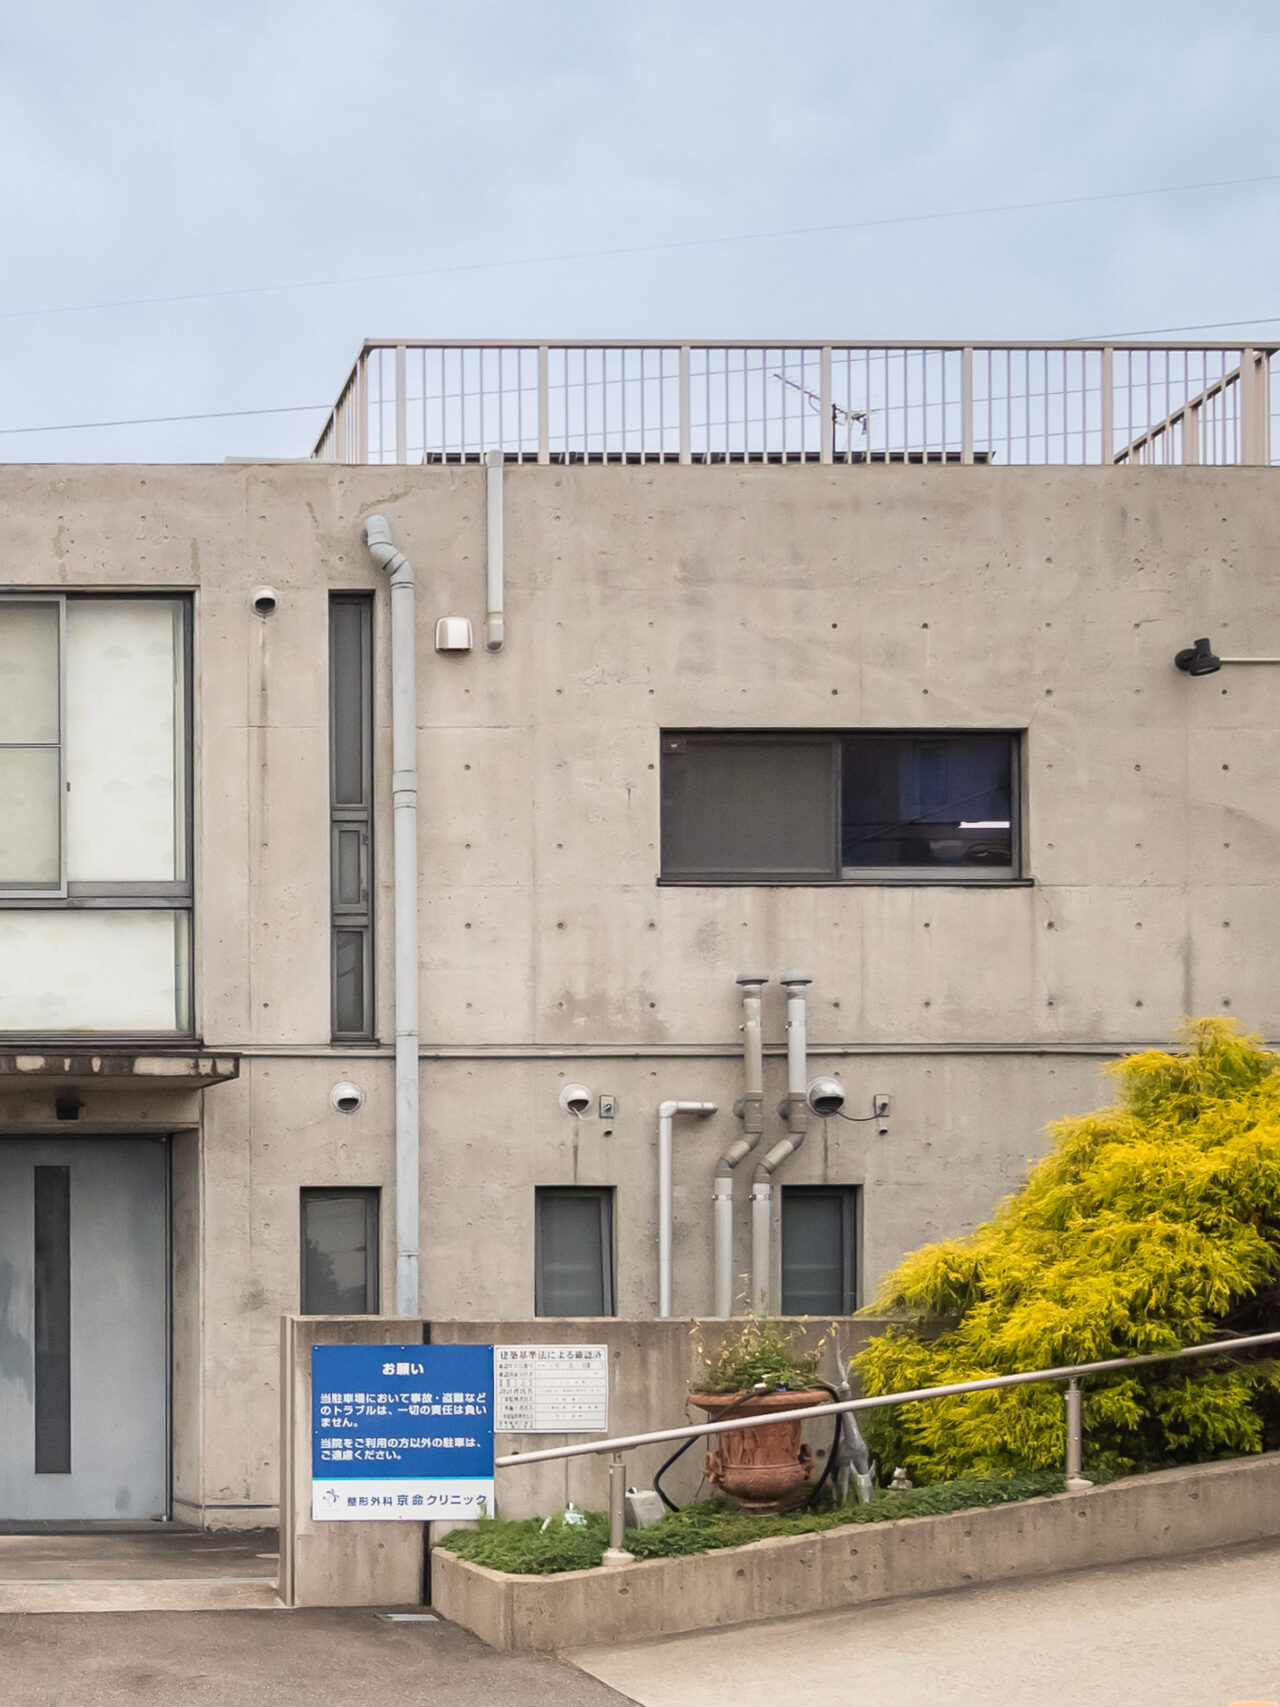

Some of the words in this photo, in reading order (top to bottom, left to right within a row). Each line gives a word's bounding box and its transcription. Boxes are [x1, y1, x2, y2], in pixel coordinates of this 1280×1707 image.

[382, 1363, 424, 1376] お願い
[320, 1393, 487, 1404] 当駐車場において事故・盗難など
[320, 1405, 487, 1416] のトラブルは、一切の責任は負い
[321, 1418, 359, 1428] ません。
[320, 1438, 482, 1449] 当院をご利用の方以外の駐車は、
[321, 1451, 402, 1461] ご遠慮ください。
[347, 1497, 393, 1507] 整形外科
[396, 1494, 487, 1506] 京命クリニック
